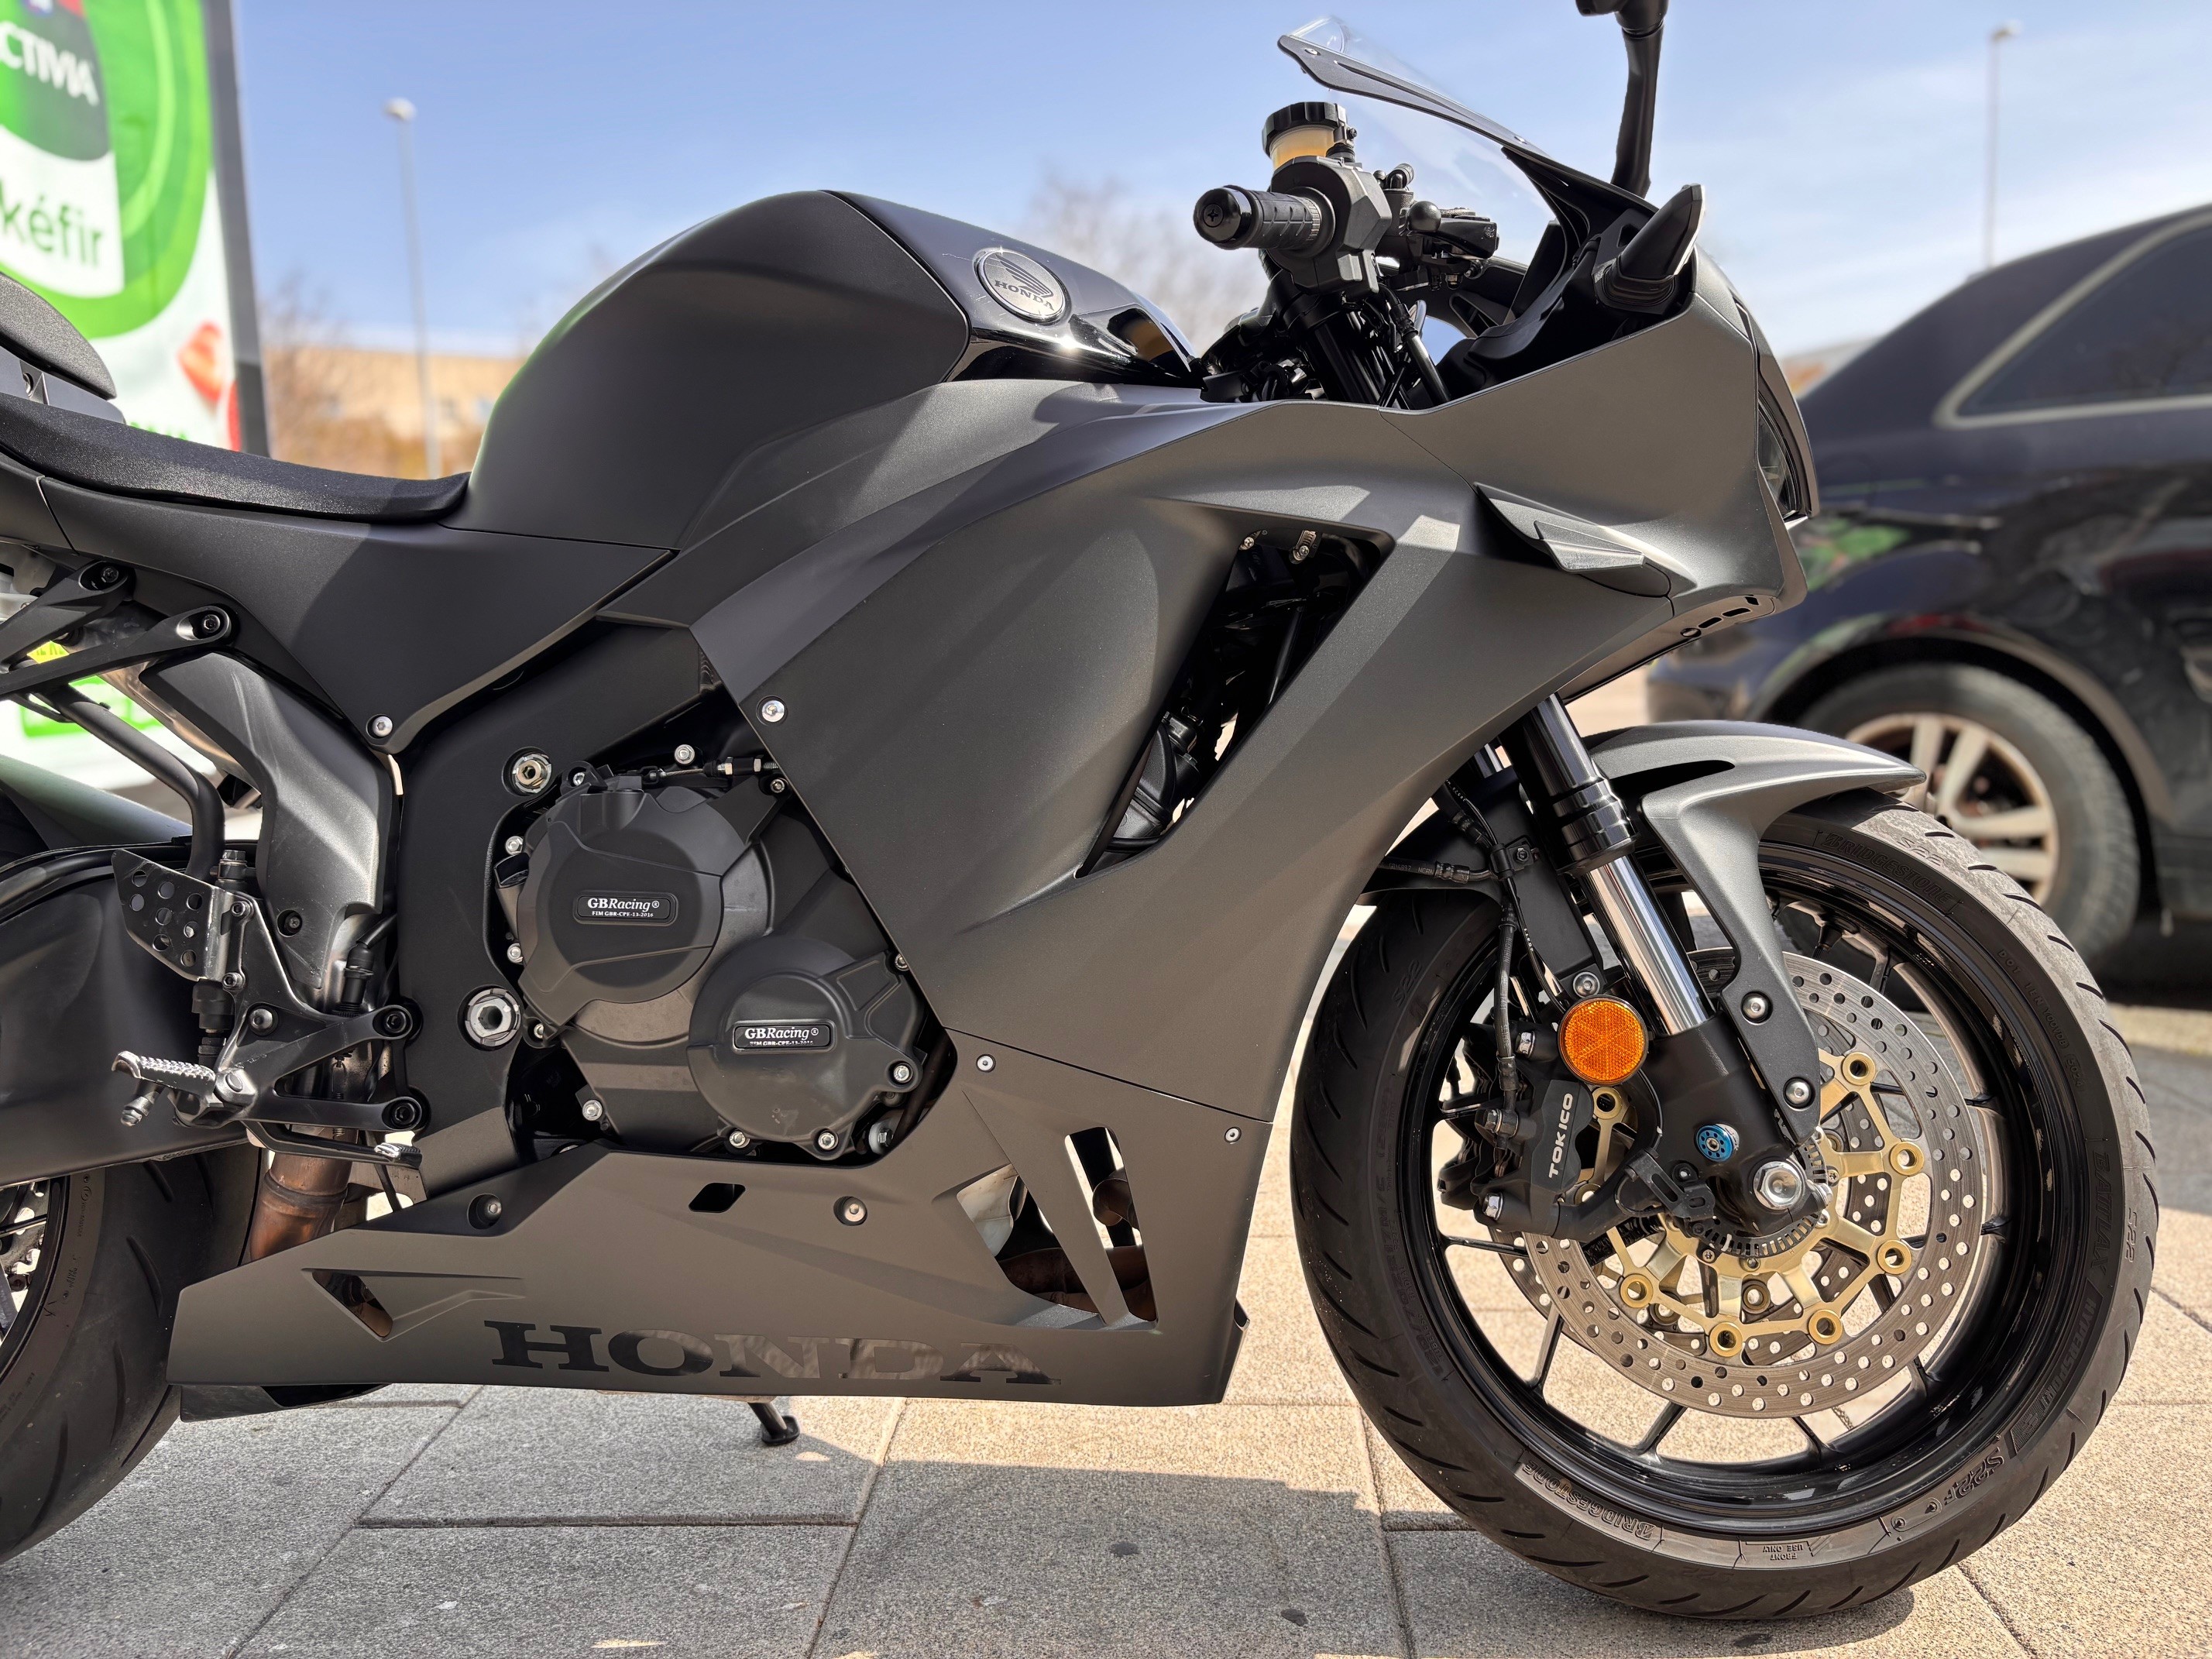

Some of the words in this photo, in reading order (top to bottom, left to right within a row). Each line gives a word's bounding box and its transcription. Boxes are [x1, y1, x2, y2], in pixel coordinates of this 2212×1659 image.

[0, 177, 103, 268] kéfir
[994, 280, 1054, 311] HONDA
[1822, 833, 1953, 904] BRIDGESTONE
[1997, 949, 2022, 974] DOT
[1548, 1093, 1573, 1178] TOKICO
[2124, 1207, 2138, 1263] S22
[484, 1320, 1062, 1385] HONDA
[1522, 1459, 1657, 1540] BRIDGESTONE
[1762, 1544, 1783, 1553] ONLY
[1770, 1552, 1798, 1561] FRONT
[1786, 1544, 1804, 1552] USE
